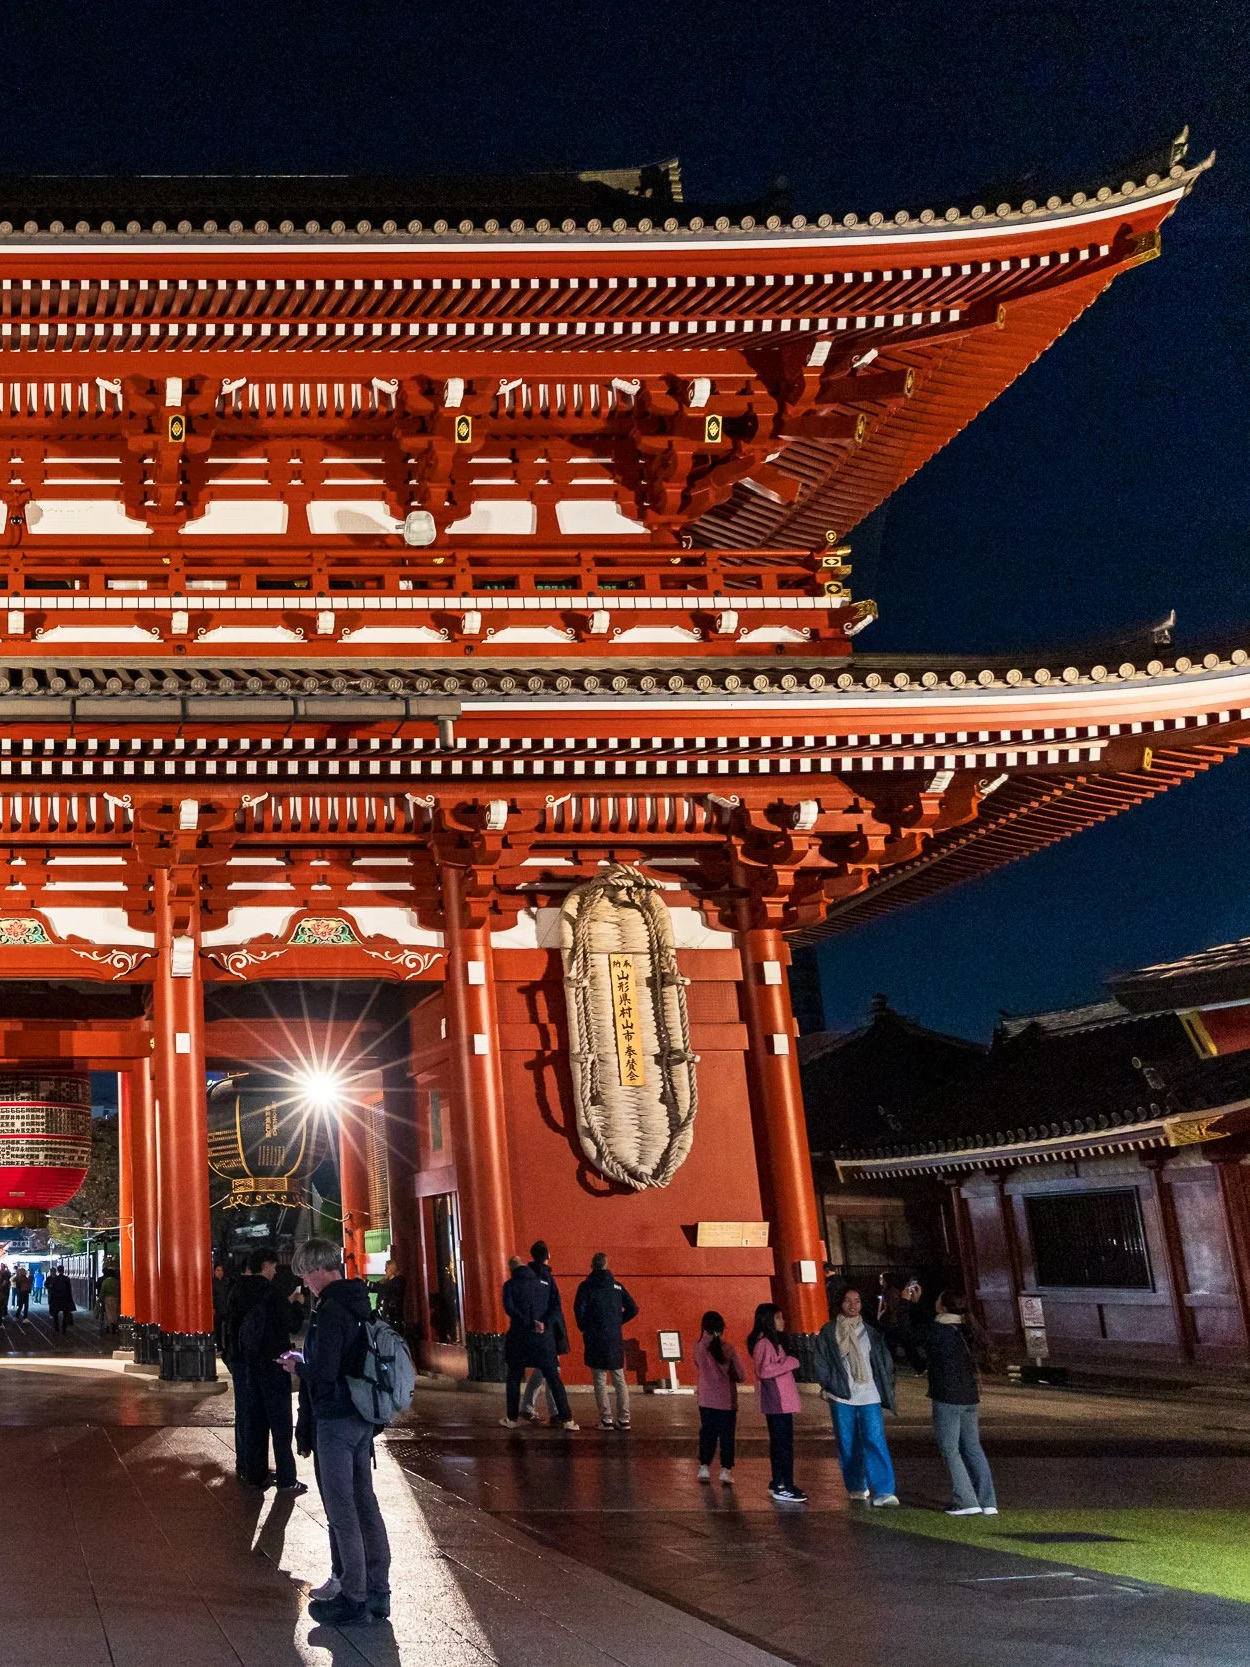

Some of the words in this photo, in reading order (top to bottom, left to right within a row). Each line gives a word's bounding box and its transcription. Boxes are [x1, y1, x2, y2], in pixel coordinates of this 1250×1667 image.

[616, 970, 639, 1082] 山形県村山市奉賛会
